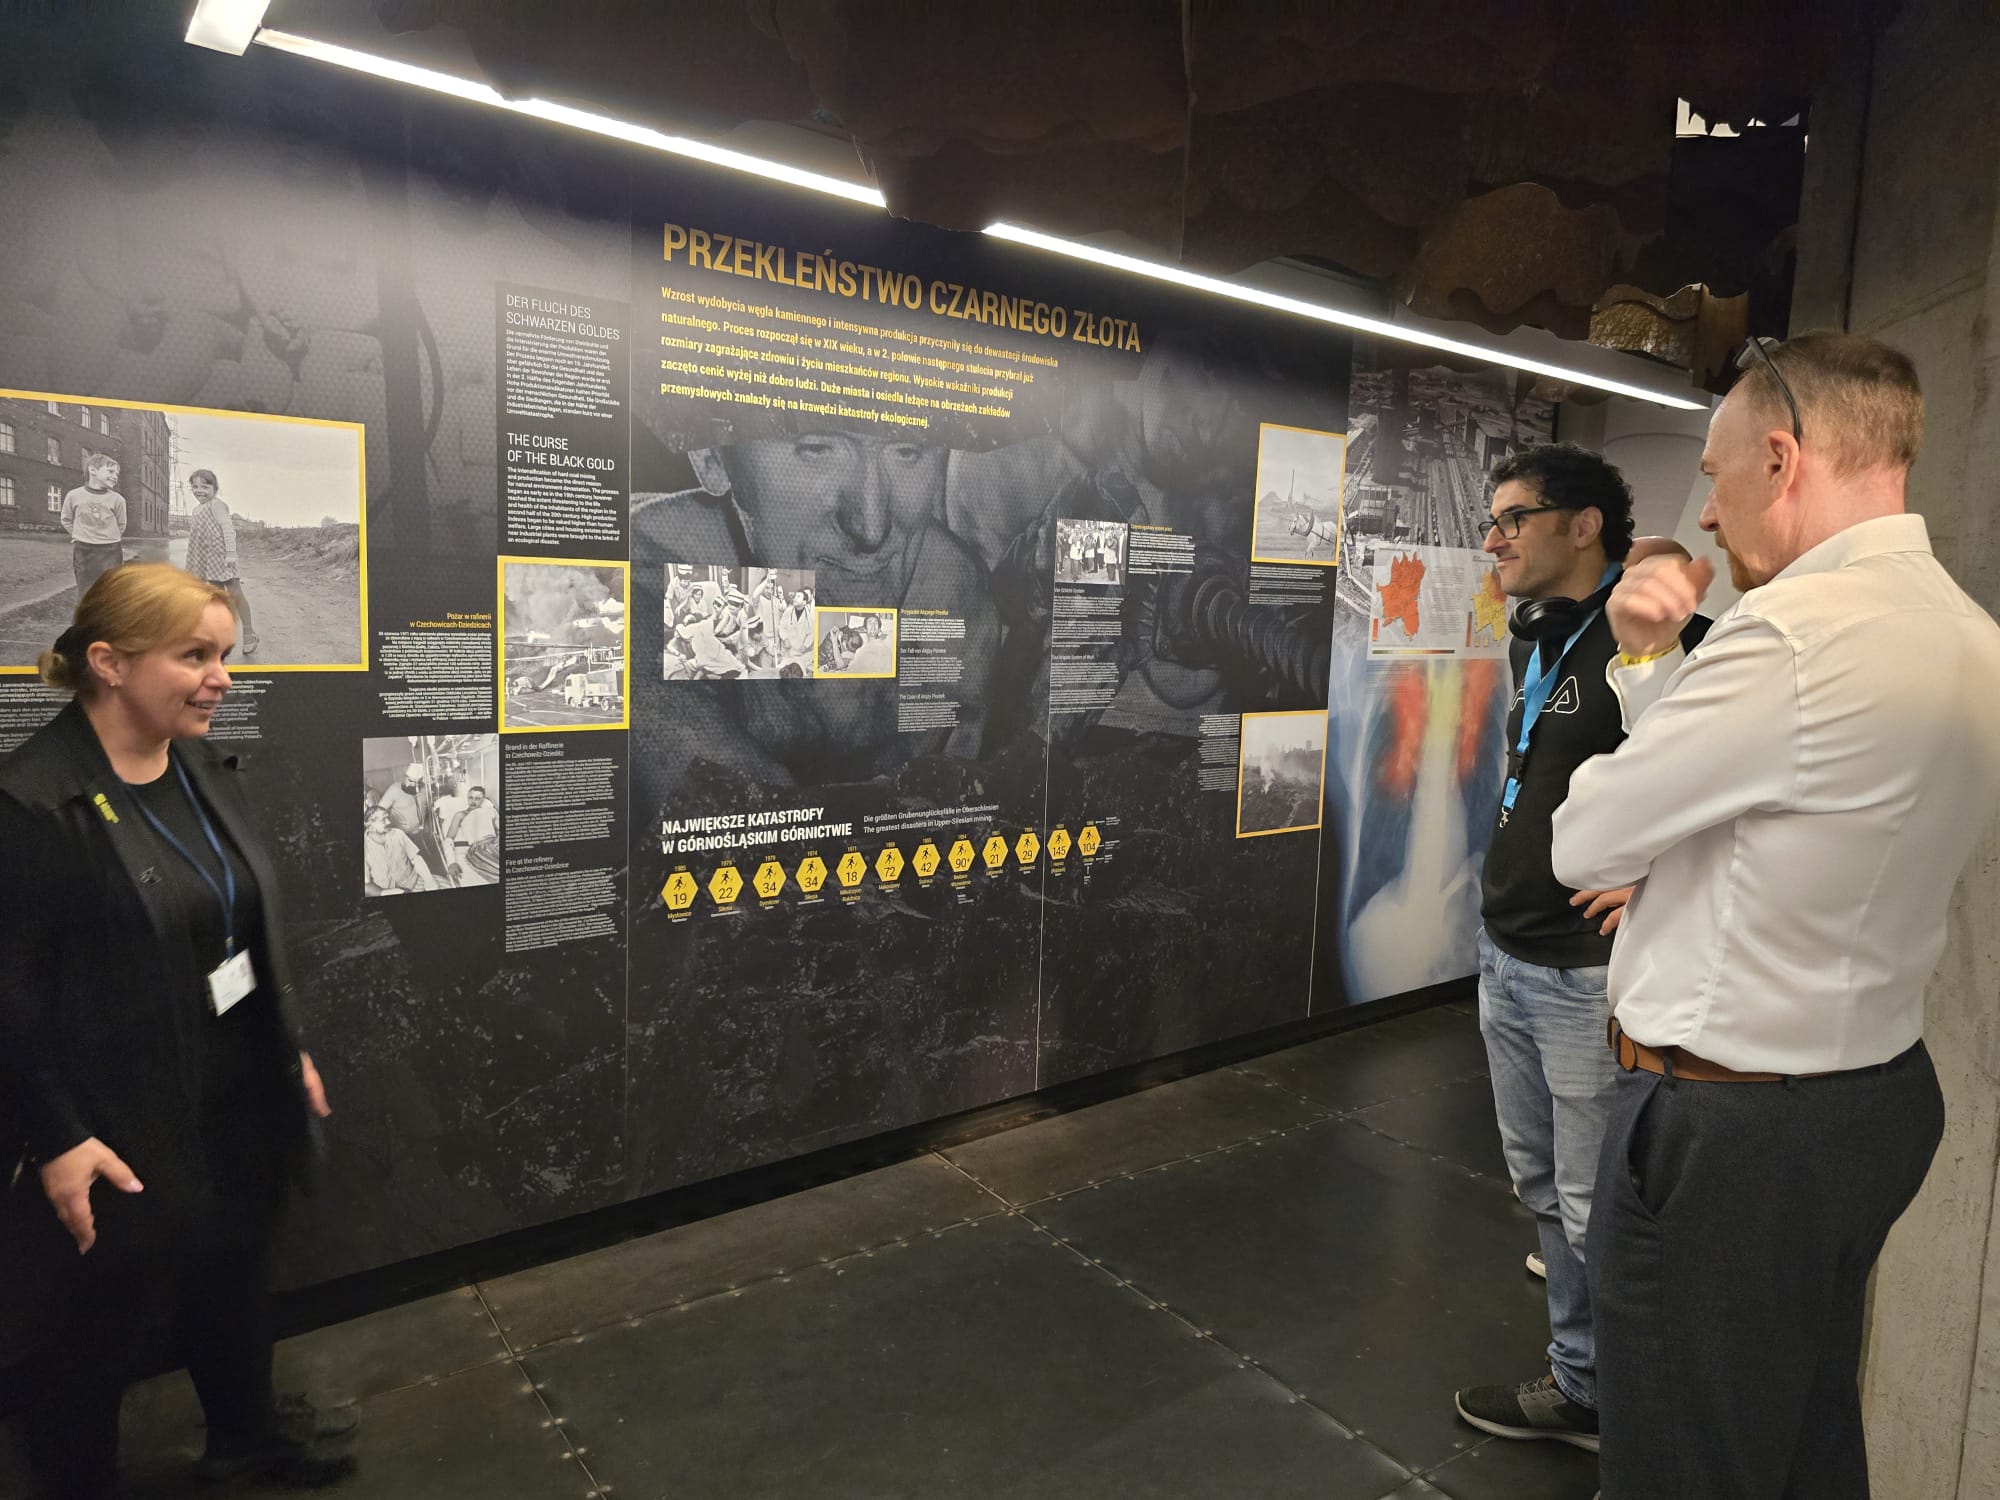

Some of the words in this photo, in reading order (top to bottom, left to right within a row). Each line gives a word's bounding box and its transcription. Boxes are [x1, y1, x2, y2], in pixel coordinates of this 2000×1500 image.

[663, 222, 922, 310] PRZEKLEŃSTWO
[930, 280, 1067, 338] CZARNEGO
[1072, 310, 1141, 353] ZŁOTA
[506, 294, 529, 309] DER
[531, 298, 567, 315] FLUCH
[570, 304, 591, 319] DES
[506, 311, 576, 334] SCHWARZEN
[578, 323, 621, 340] GOLDES
[662, 286, 694, 302] Wzrost
[697, 295, 745, 311] wydobycia
[747, 305, 773, 317] węgla
[775, 307, 826, 328] kamiennego
[828, 319, 831, 327] i
[833, 319, 878, 335] intensywna
[880, 329, 917, 344] produkcja
[919, 336, 959, 352] przyczyniły
[961, 343, 972, 354] się
[974, 343, 982, 354] do
[984, 346, 1019, 362] dewastacji
[1021, 352, 1058, 367] środowiska
[661, 312, 720, 331] naturalnego.
[723, 321, 753, 336] Proces
[756, 329, 797, 345] rozpoczął
[800, 336, 811, 348] się
[814, 338, 821, 347] w
[823, 338, 837, 350] XIX
[839, 342, 865, 356] wieku,
[873, 349, 880, 357] w
[882, 348, 889, 358] 2.
[891, 351, 920, 364] połowie
[922, 357, 963, 372] następnego
[966, 364, 992, 376] stulecia
[994, 369, 1021, 380] przybrał
[1022, 373, 1033, 383] już
[661, 336, 702, 352] rozmiary
[705, 343, 758, 360] zagrażające
[760, 350, 794, 365] zdrowiu
[796, 355, 799, 365] i
[801, 356, 822, 369] życiu
[825, 361, 878, 377] mieszkańców
[880, 370, 910, 383] regionu.
[912, 374, 943, 388] Wysokie
[945, 380, 979, 393] wskaźniki
[981, 386, 1013, 400] produkcji
[661, 359, 697, 374] zaczęto
[700, 364, 724, 376] cenić
[726, 368, 751, 383] wyżej
[754, 371, 767, 383] niż
[769, 373, 793, 386] dobro
[796, 376, 818, 390] ludzi.
[820, 381, 840, 393] Duże
[842, 385, 869, 397] miasta
[872, 390, 874, 398] i
[876, 390, 902, 402] osiedla
[905, 393, 928, 407] leżące
[930, 399, 939, 408] na
[941, 399, 976, 413] obrzeżach
[978, 405, 1010, 417] zakładów
[661, 383, 732, 401] przemysłowych
[734, 392, 770, 408] znalazły
[772, 398, 785, 409] się
[787, 400, 797, 409] na
[799, 399, 836, 415] krawędzi
[838, 404, 878, 422] katastrofy
[880, 411, 929, 428] ekologicznej.
[507, 432, 530, 447] THE
[532, 435, 569, 450] CURSE
[507, 449, 522, 462] OF
[524, 451, 547, 465] THE
[549, 453, 585, 469] BLACK
[586, 457, 615, 471] GOLD
[662, 814, 745, 835] NAJWIĘKSZE
[747, 807, 825, 827] KATASTROFY
[874, 813, 897, 822] größten
[961, 804, 999, 812] Oberschlesien
[875, 823, 900, 833] greatest
[900, 821, 927, 829] disasters
[661, 840, 675, 854] W
[677, 830, 778, 853] GÓRNOŚLĄSKIM
[780, 822, 853, 842] GÓRNICTWIE
[1022, 850, 1033, 861] 29
[1053, 845, 1066, 856] 145
[1083, 842, 1095, 853] 104
[920, 862, 932, 873] 42
[990, 854, 999, 865] 21
[845, 871, 858, 883] 18
[883, 866, 896, 877] 72
[762, 882, 777, 893] 34
[804, 876, 818, 888] 34
[673, 893, 687, 905] 19
[718, 887, 733, 899] 22
